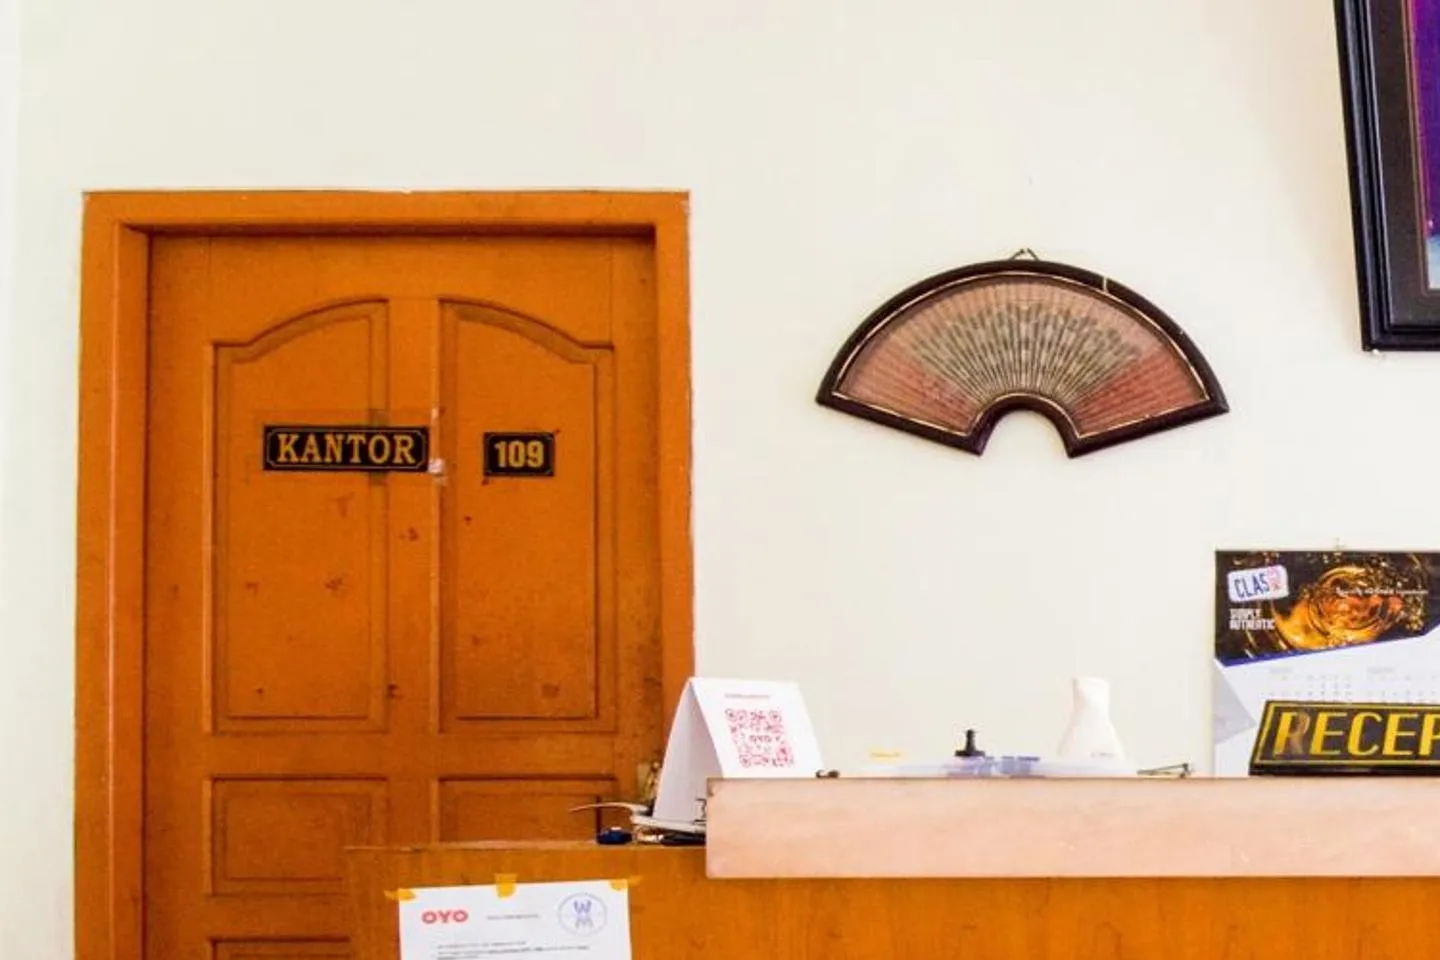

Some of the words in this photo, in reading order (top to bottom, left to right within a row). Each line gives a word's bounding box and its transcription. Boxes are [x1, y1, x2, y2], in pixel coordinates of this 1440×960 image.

[276, 432, 416, 464] KANTOR
[494, 440, 545, 468] 109
[421, 909, 469, 924] OYO
